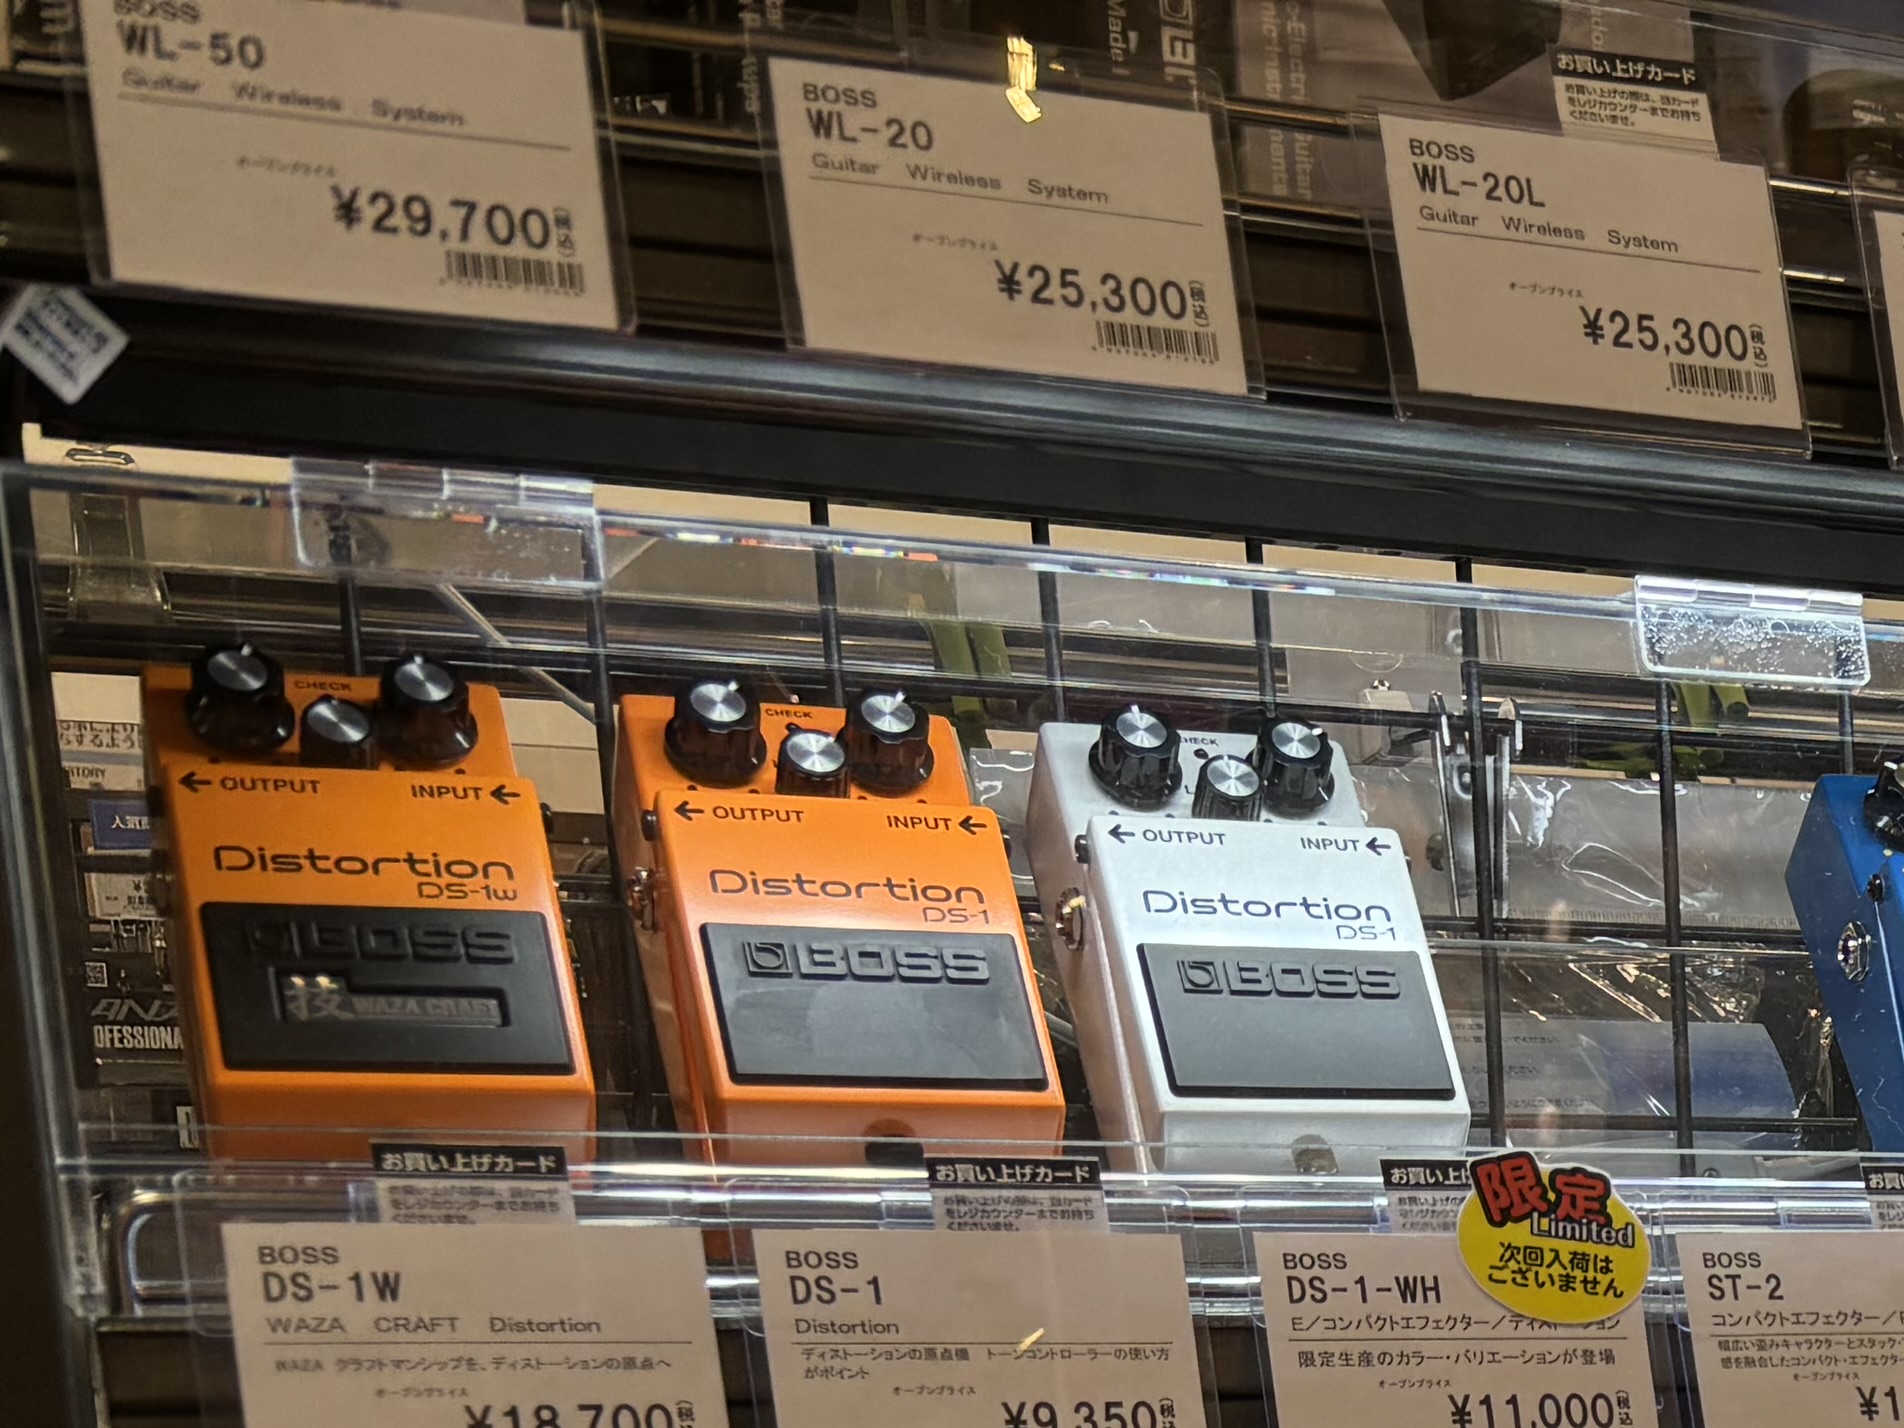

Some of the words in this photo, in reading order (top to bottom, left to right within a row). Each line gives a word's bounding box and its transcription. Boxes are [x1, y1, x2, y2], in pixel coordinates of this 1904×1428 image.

[117, 21, 266, 69] WL-50
[1556, 53, 1696, 84] お買い上げカード
[806, 110, 933, 152] WL-20
[813, 153, 879, 176] Guitar
[907, 164, 1000, 191] Wireless
[1028, 178, 1107, 205] System
[1413, 164, 1545, 208] WL-20L
[332, 185, 551, 249] ¥29,700
[997, 261, 1186, 320] ¥25,300
[1581, 306, 1747, 361] ¥25,300
[221, 776, 320, 794] OUTPUT
[411, 784, 483, 801] INPUT
[214, 845, 514, 881] Distortion
[710, 870, 984, 904] Distortion
[922, 906, 989, 923] DS-1
[1142, 889, 1391, 922] Distortion
[1336, 924, 1397, 941] DS-1
[1531, 1217, 1635, 1248] Limited
[258, 1245, 339, 1266] BOSS
[1498, 1242, 1614, 1276] 次回入荷は
[263, 1271, 402, 1305] DS-1W
[790, 1276, 884, 1306] DS-1
[1287, 1274, 1442, 1306] DS-1-WH
[1488, 1268, 1624, 1300] ございません
[1708, 1273, 1784, 1303] ST-2
[267, 1316, 345, 1335] WAZA
[374, 1316, 459, 1335] CRAFT
[490, 1316, 601, 1335] Distortion
